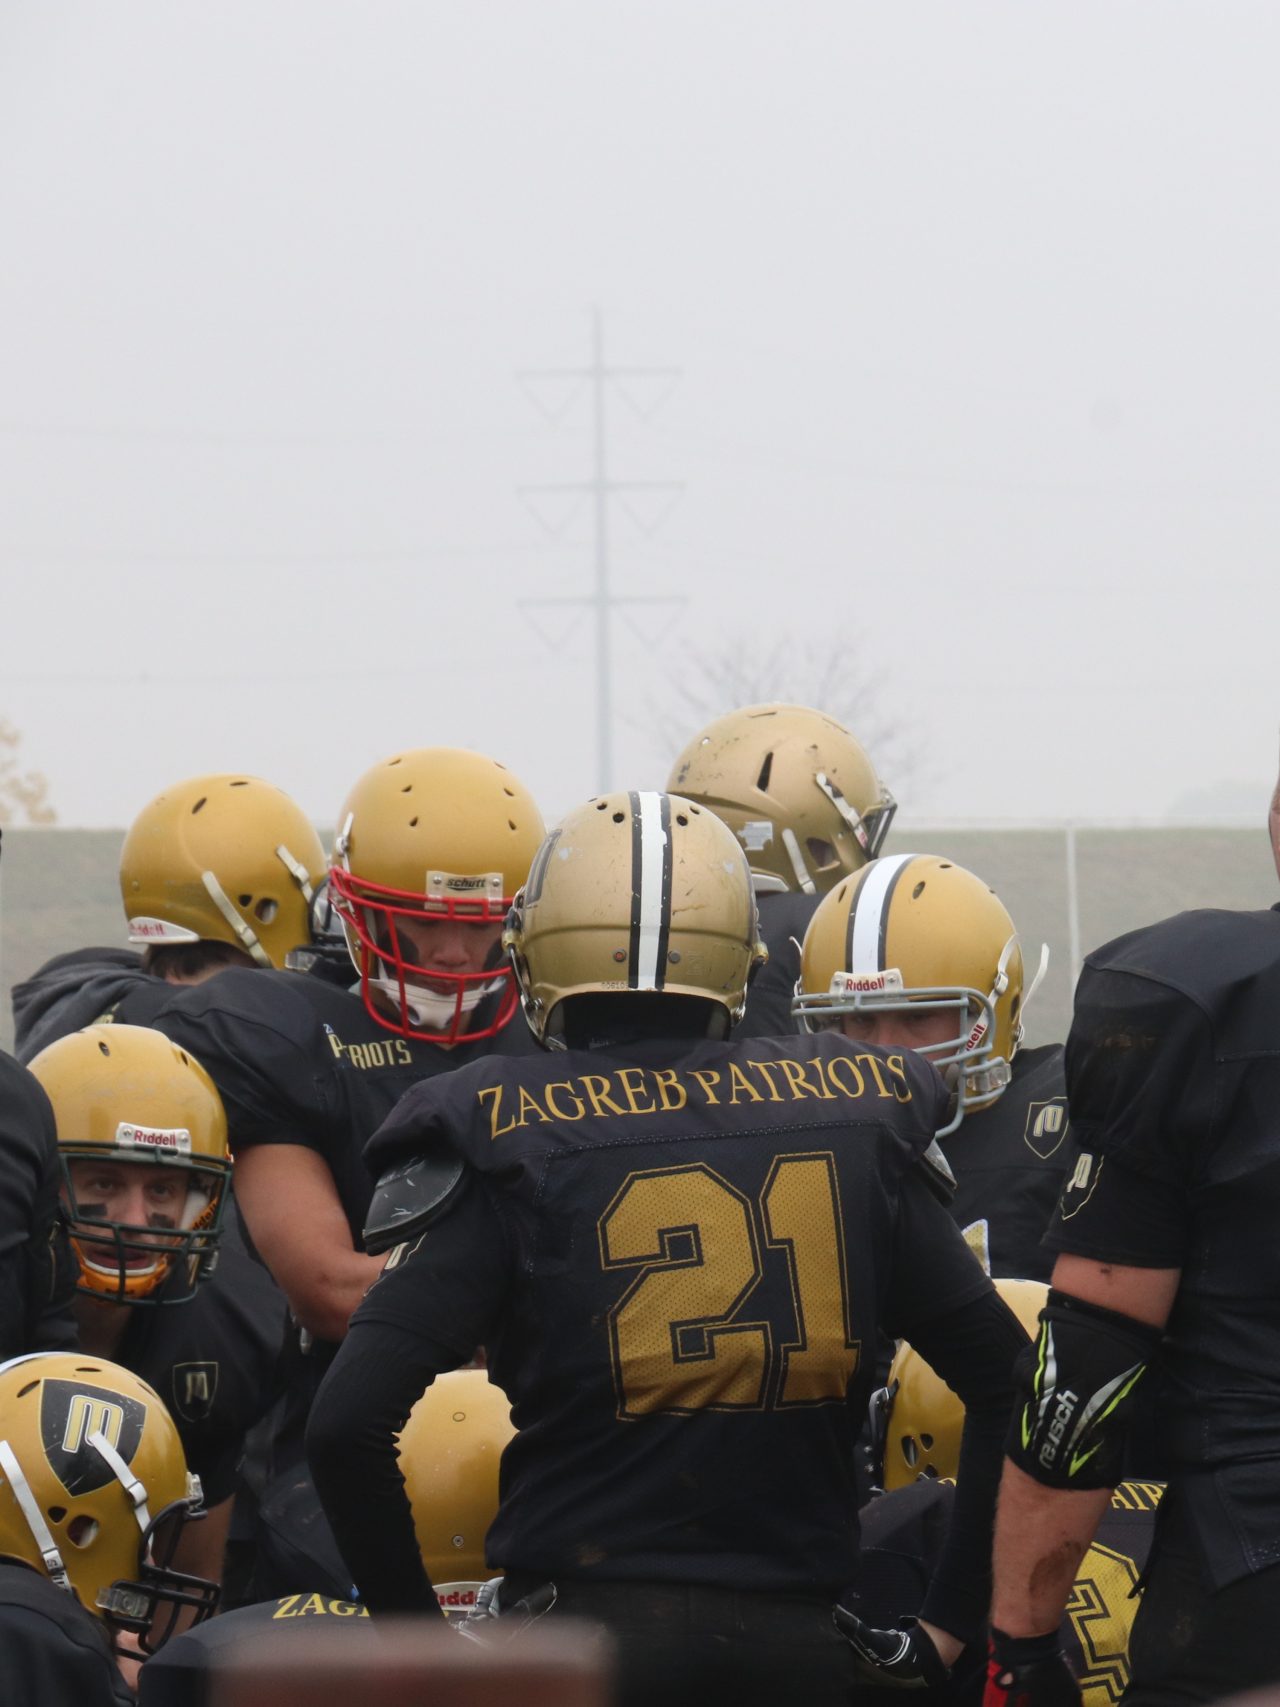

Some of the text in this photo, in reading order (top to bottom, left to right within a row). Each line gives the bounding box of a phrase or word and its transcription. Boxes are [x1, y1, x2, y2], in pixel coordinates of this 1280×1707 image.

[845, 977, 885, 992] Riddell
[477, 1054, 913, 1141] ZAGREB PATRIOTS
[134, 1129, 177, 1147] Riddell
[597, 1151, 862, 1423] 21
